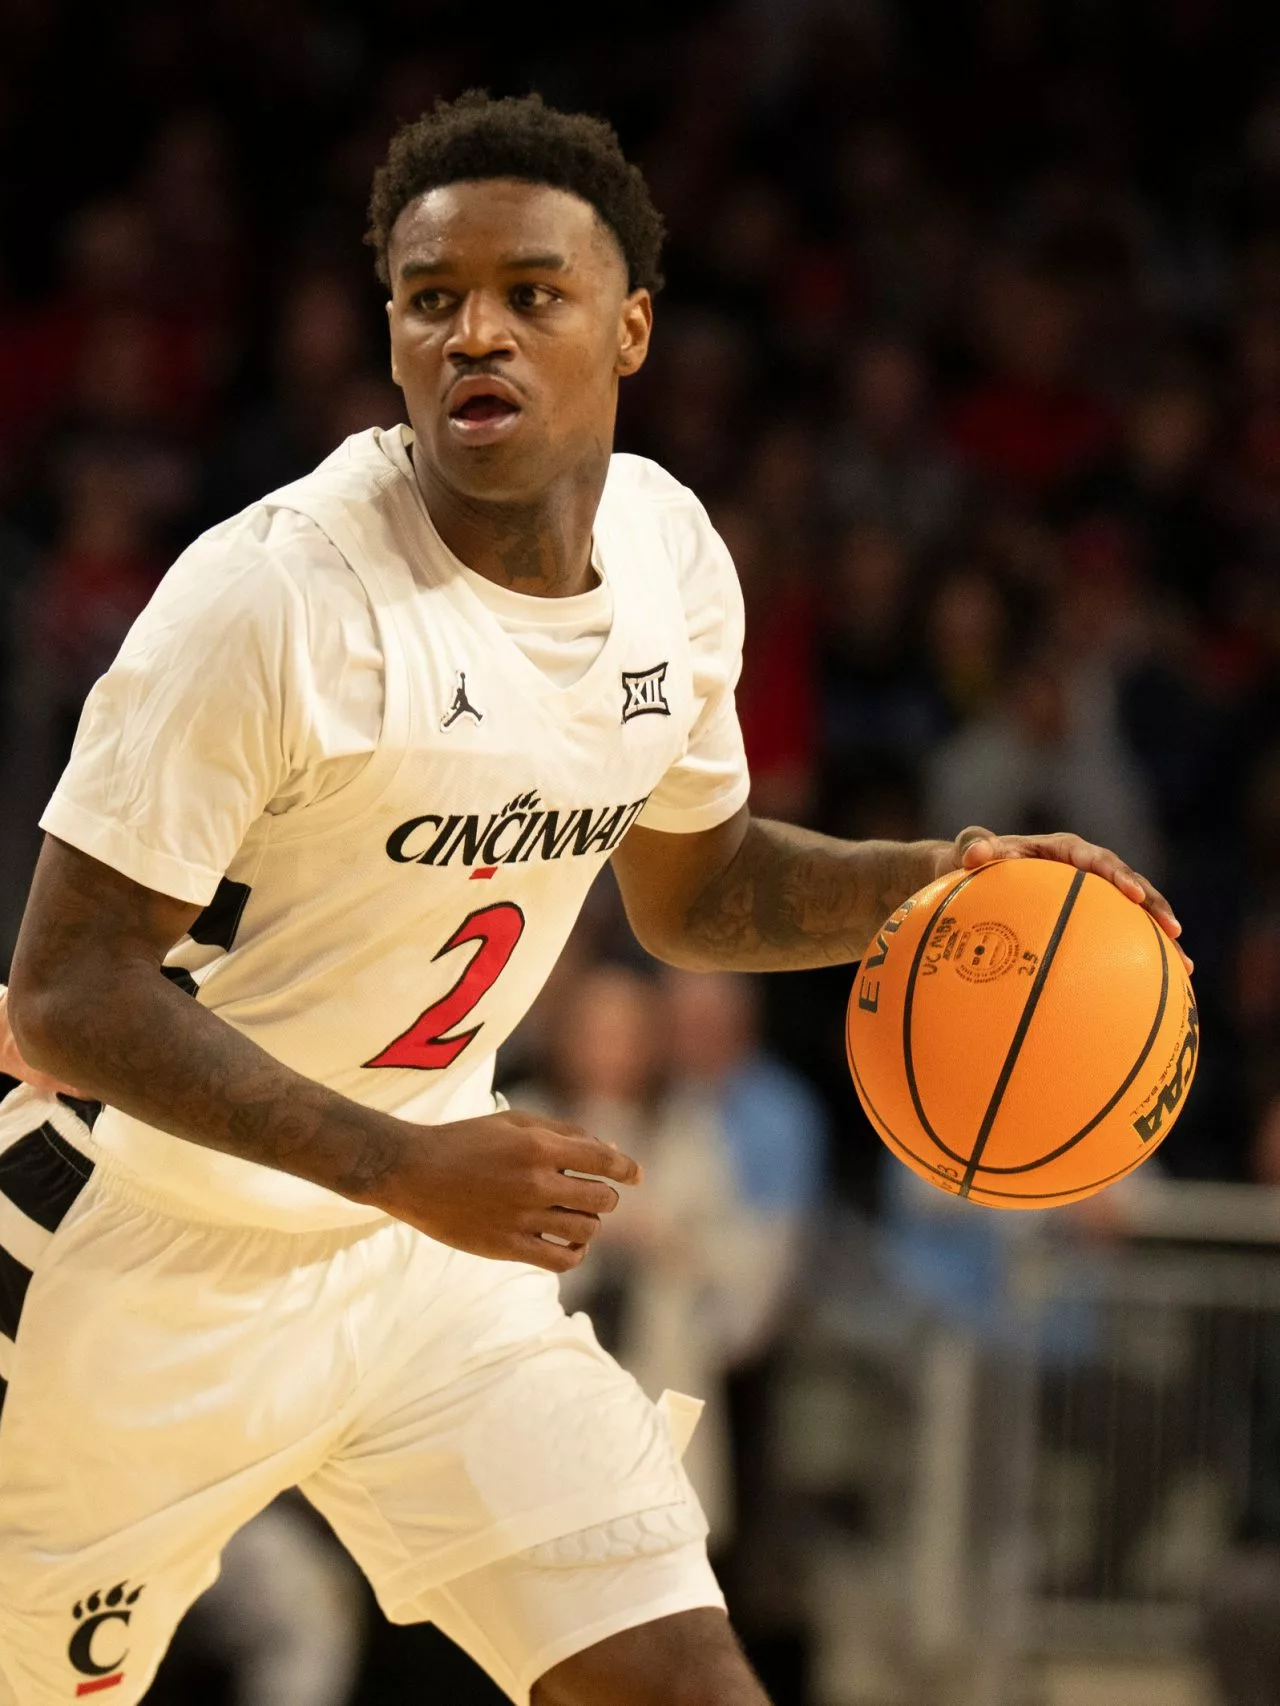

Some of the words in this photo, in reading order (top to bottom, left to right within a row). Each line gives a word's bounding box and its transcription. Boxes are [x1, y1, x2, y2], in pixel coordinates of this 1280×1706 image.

[386, 789, 652, 867] CINCINNAT
[360, 901, 525, 1069] 2
[67, 1610, 132, 1677] C
